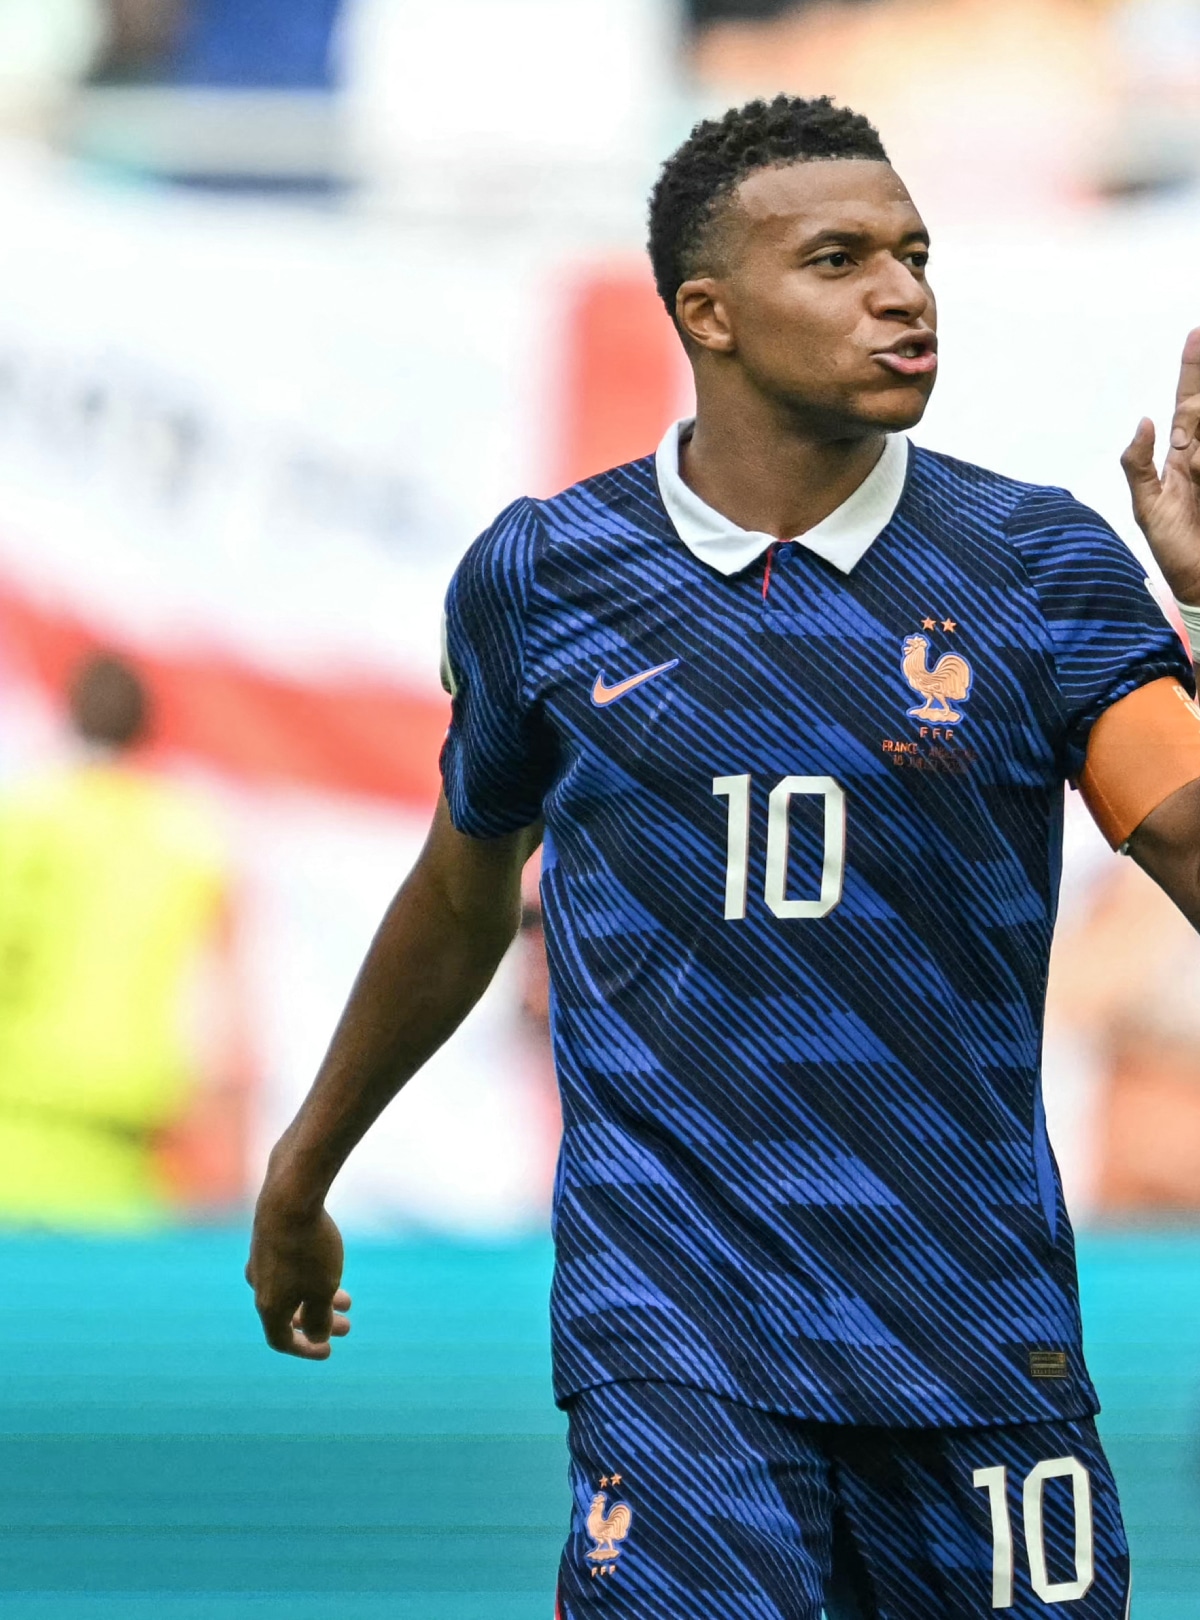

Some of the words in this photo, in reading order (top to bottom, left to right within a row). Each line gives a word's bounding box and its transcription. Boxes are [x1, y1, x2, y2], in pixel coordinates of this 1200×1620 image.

[882, 740, 918, 755] FRANCE
[713, 774, 844, 919] 10
[973, 1457, 1093, 1607] 10
